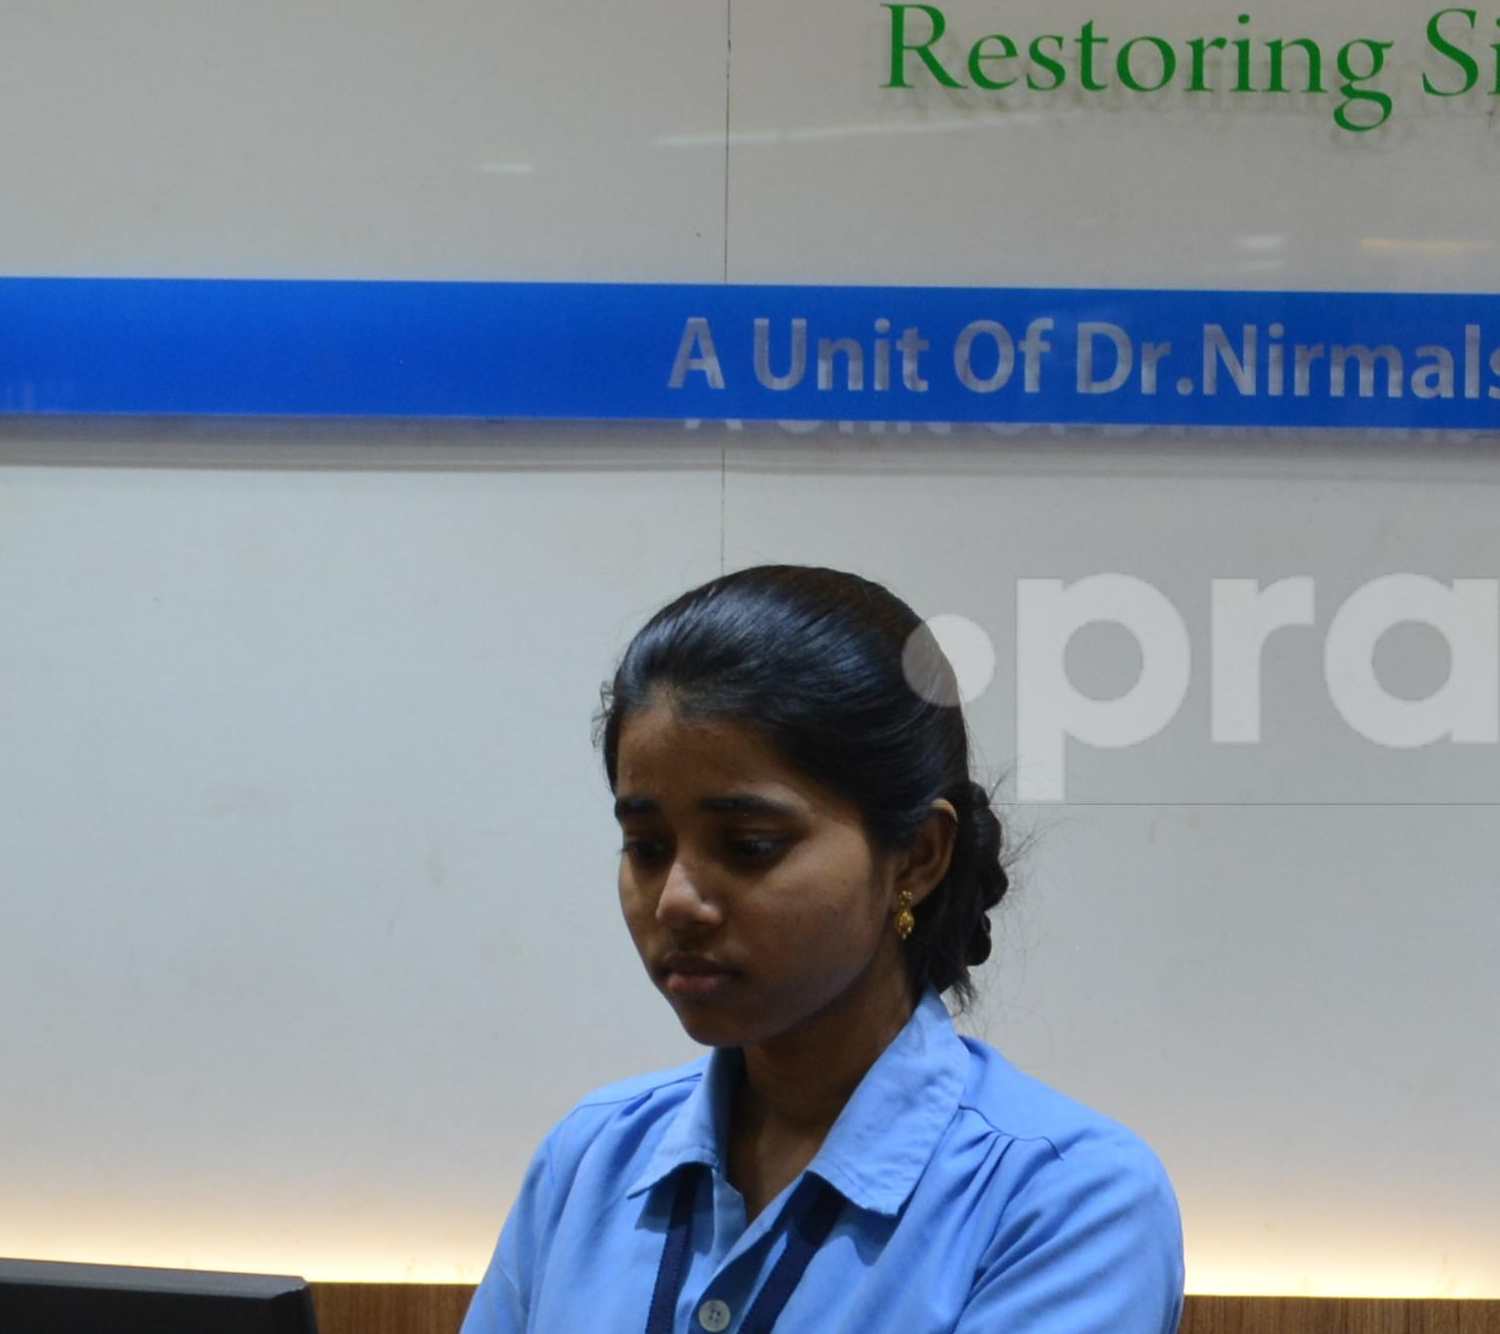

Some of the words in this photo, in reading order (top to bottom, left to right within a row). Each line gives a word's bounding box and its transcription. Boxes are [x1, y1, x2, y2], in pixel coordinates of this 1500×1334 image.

[878, 2, 1394, 133] Restoring
[667, 316, 726, 390] A
[752, 317, 931, 392] Unit
[953, 317, 1055, 394] Of
